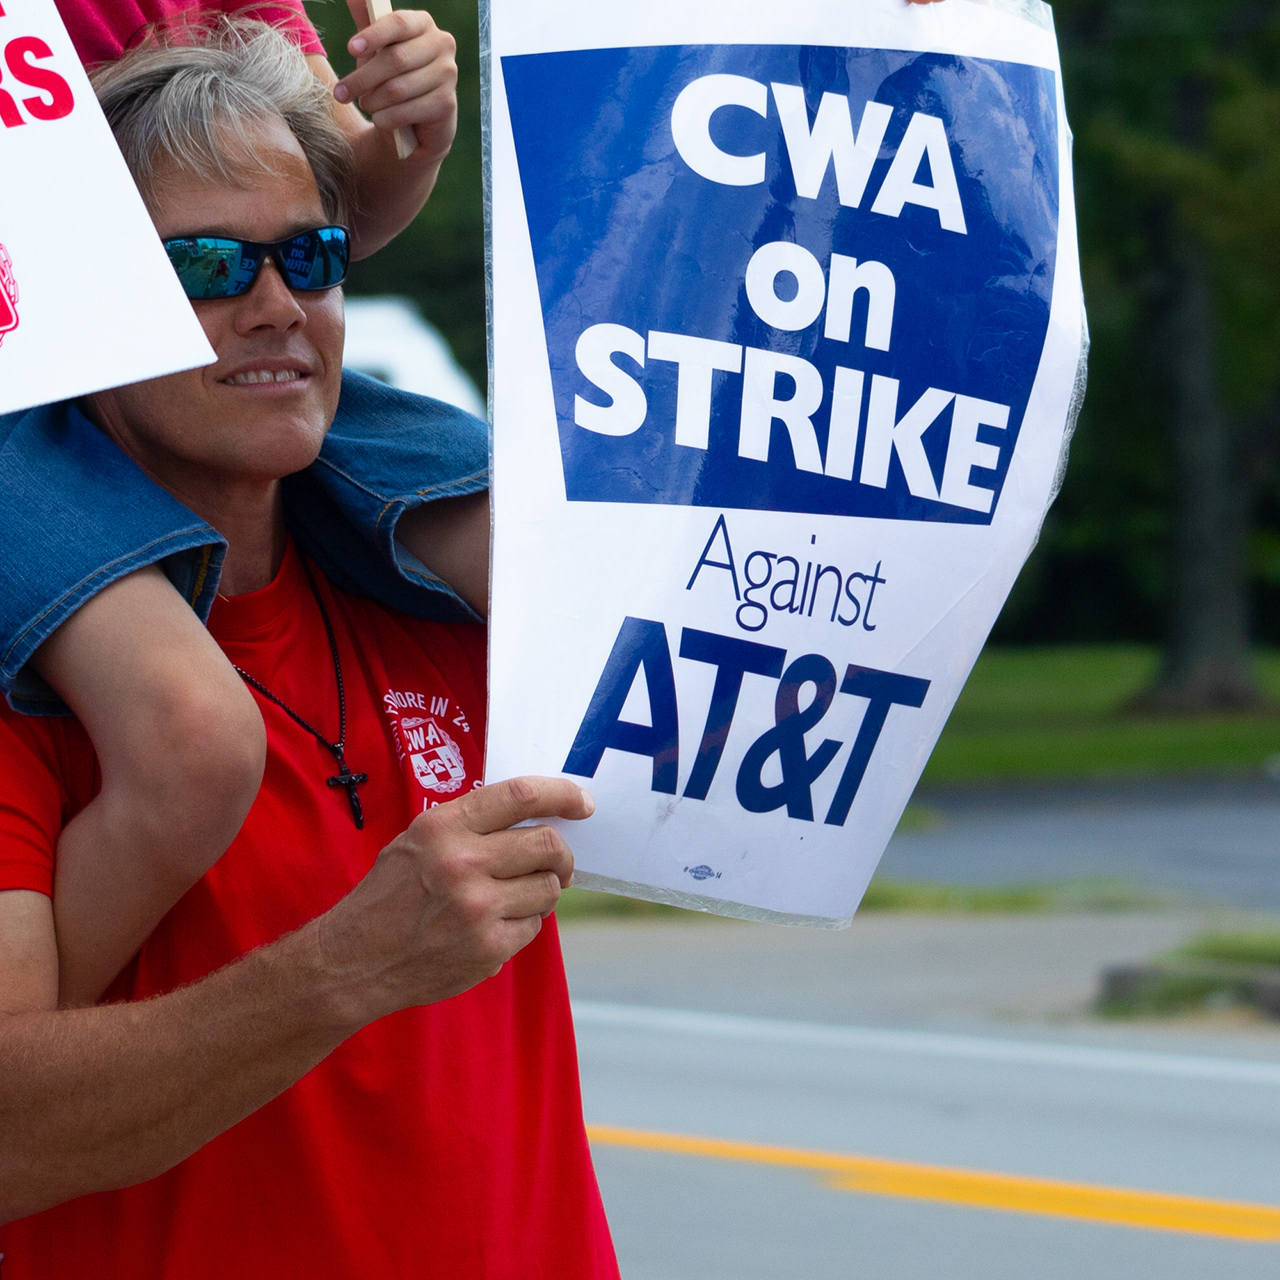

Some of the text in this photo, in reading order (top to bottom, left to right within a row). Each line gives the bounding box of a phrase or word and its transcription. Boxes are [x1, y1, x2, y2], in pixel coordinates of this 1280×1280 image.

[670, 70, 967, 234] CWA
[745, 241, 895, 351] on
[574, 323, 1010, 513] STRIKE
[686, 514, 885, 632] Against
[430, 696, 449, 717] IN
[562, 617, 930, 827] AT&T
